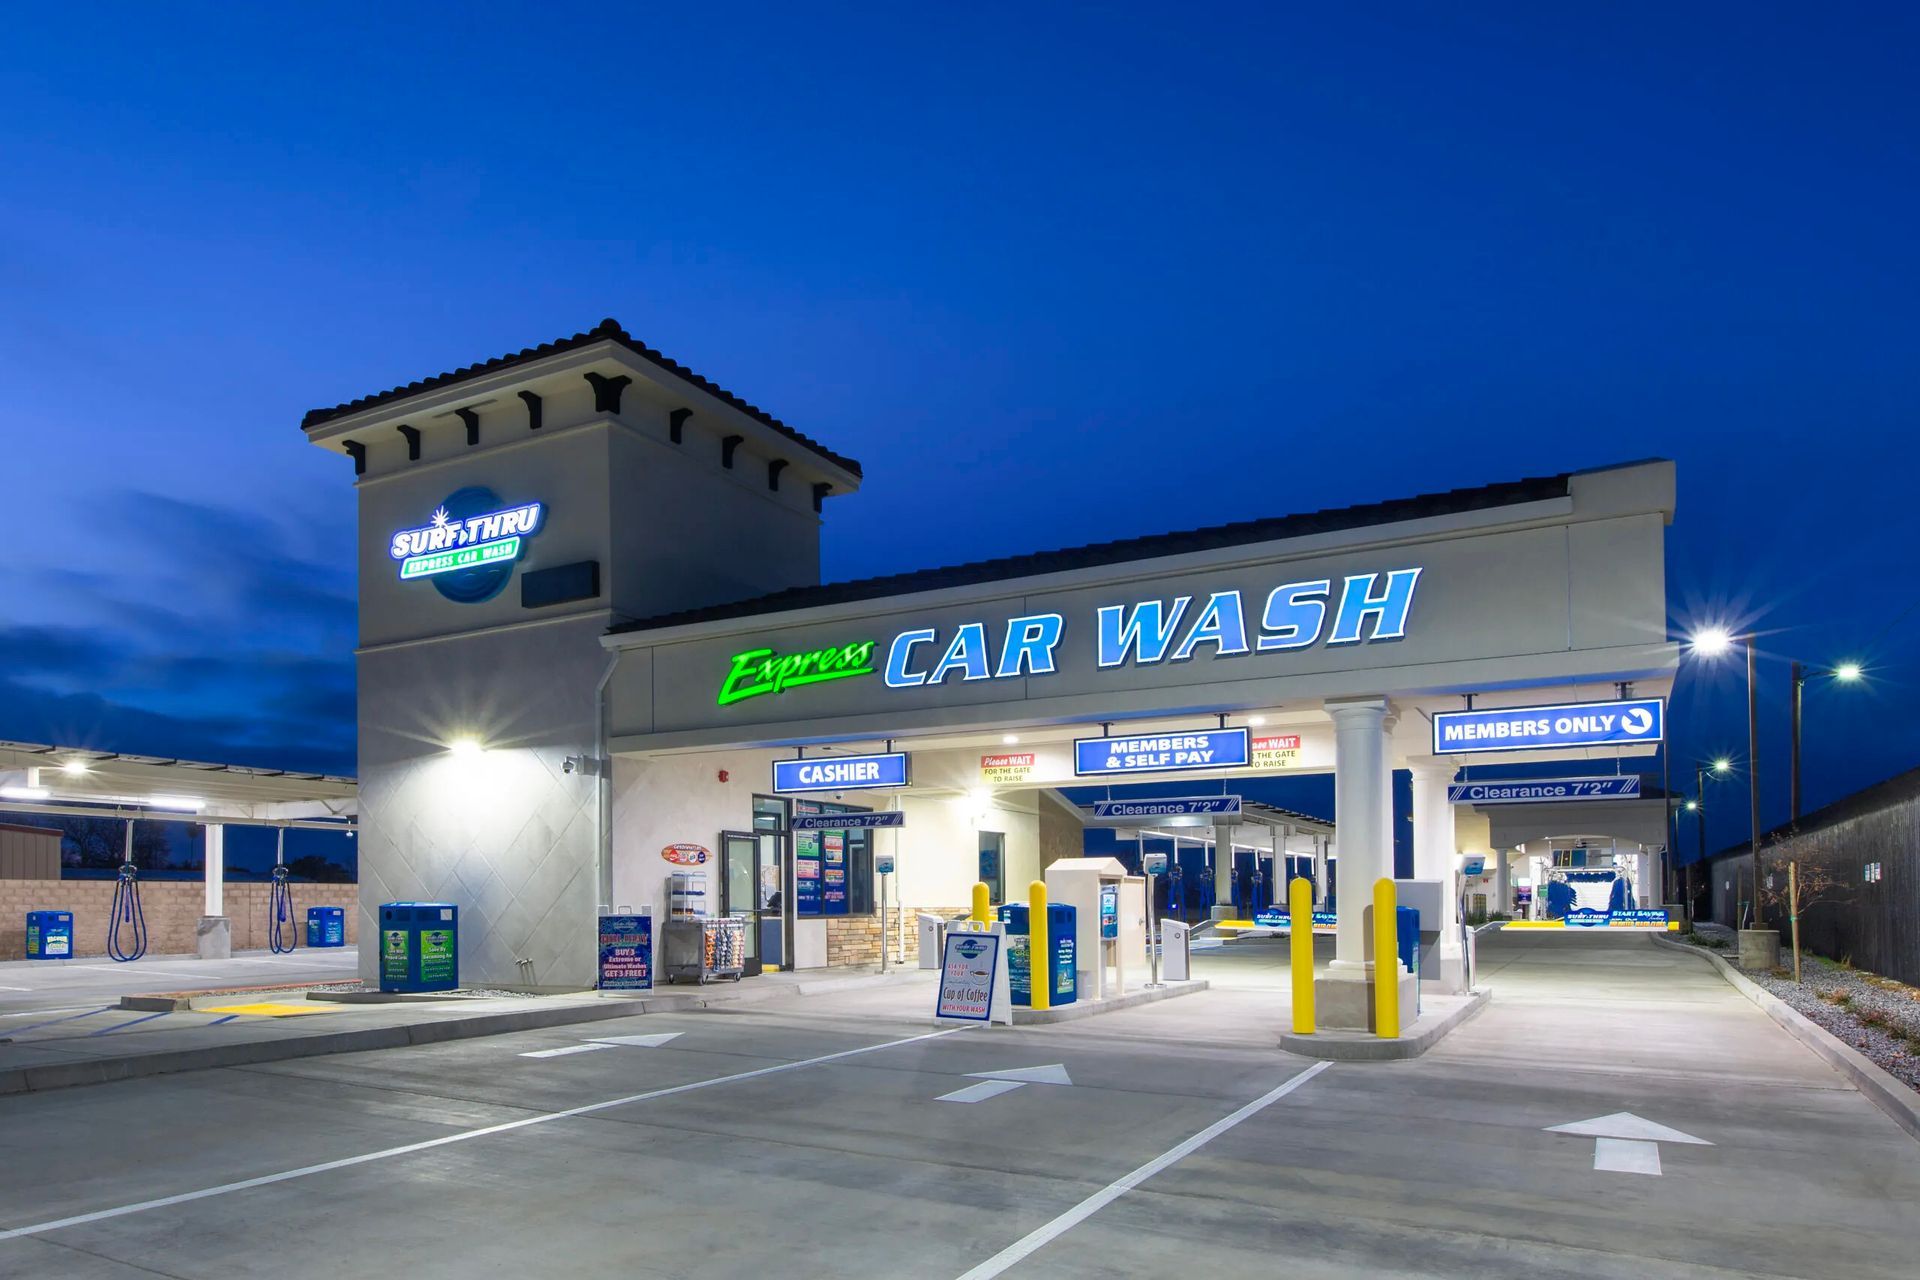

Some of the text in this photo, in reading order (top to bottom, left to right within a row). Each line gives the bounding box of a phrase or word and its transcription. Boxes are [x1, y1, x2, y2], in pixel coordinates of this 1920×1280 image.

[392, 505, 539, 557] SURF THRU
[408, 543, 513, 573] EXPRESS CAR WASH
[718, 567, 1424, 705] Express CAR WASH
[1444, 714, 1616, 740] MEMBERS ONLY
[1110, 736, 1209, 754] MEMBERS
[1268, 738, 1296, 750] WAIT
[1009, 756, 1031, 765] WAIT
[1106, 750, 1214, 768] & SELF PAY
[798, 762, 880, 784] CASHIER
[1470, 784, 1566, 799] Clearance
[1111, 803, 1184, 815] Clearance
[805, 818, 860, 828] Clearance
[943, 987, 987, 1002] Cup of Coffee
